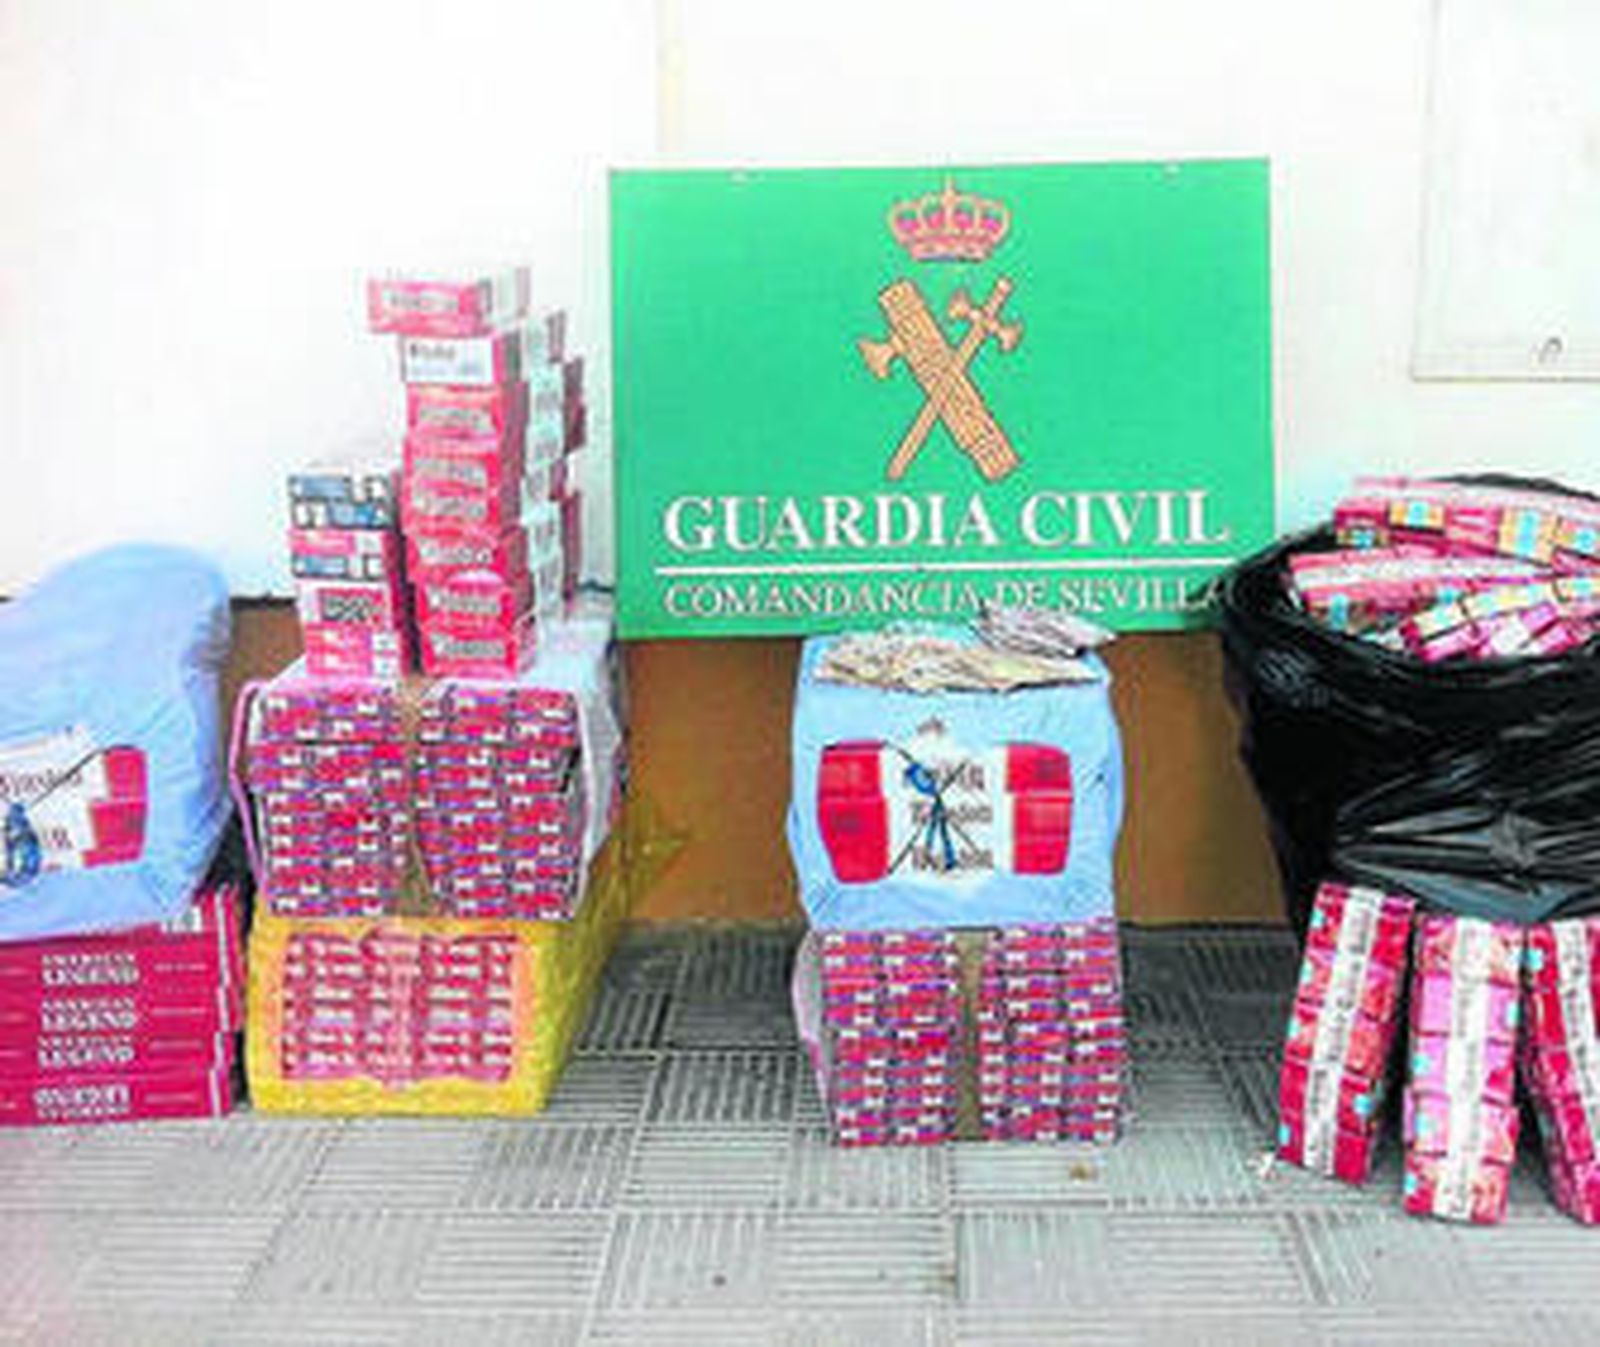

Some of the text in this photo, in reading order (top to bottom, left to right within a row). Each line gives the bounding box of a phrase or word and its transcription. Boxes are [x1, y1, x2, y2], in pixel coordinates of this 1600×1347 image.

[662, 487, 1231, 552] GUARDIA CIVIL
[663, 578, 981, 617] COMANDANCIA
[995, 576, 1048, 611] DE
[41, 1011, 137, 1031] LEGEND
[38, 1046, 135, 1070] LEGEND
